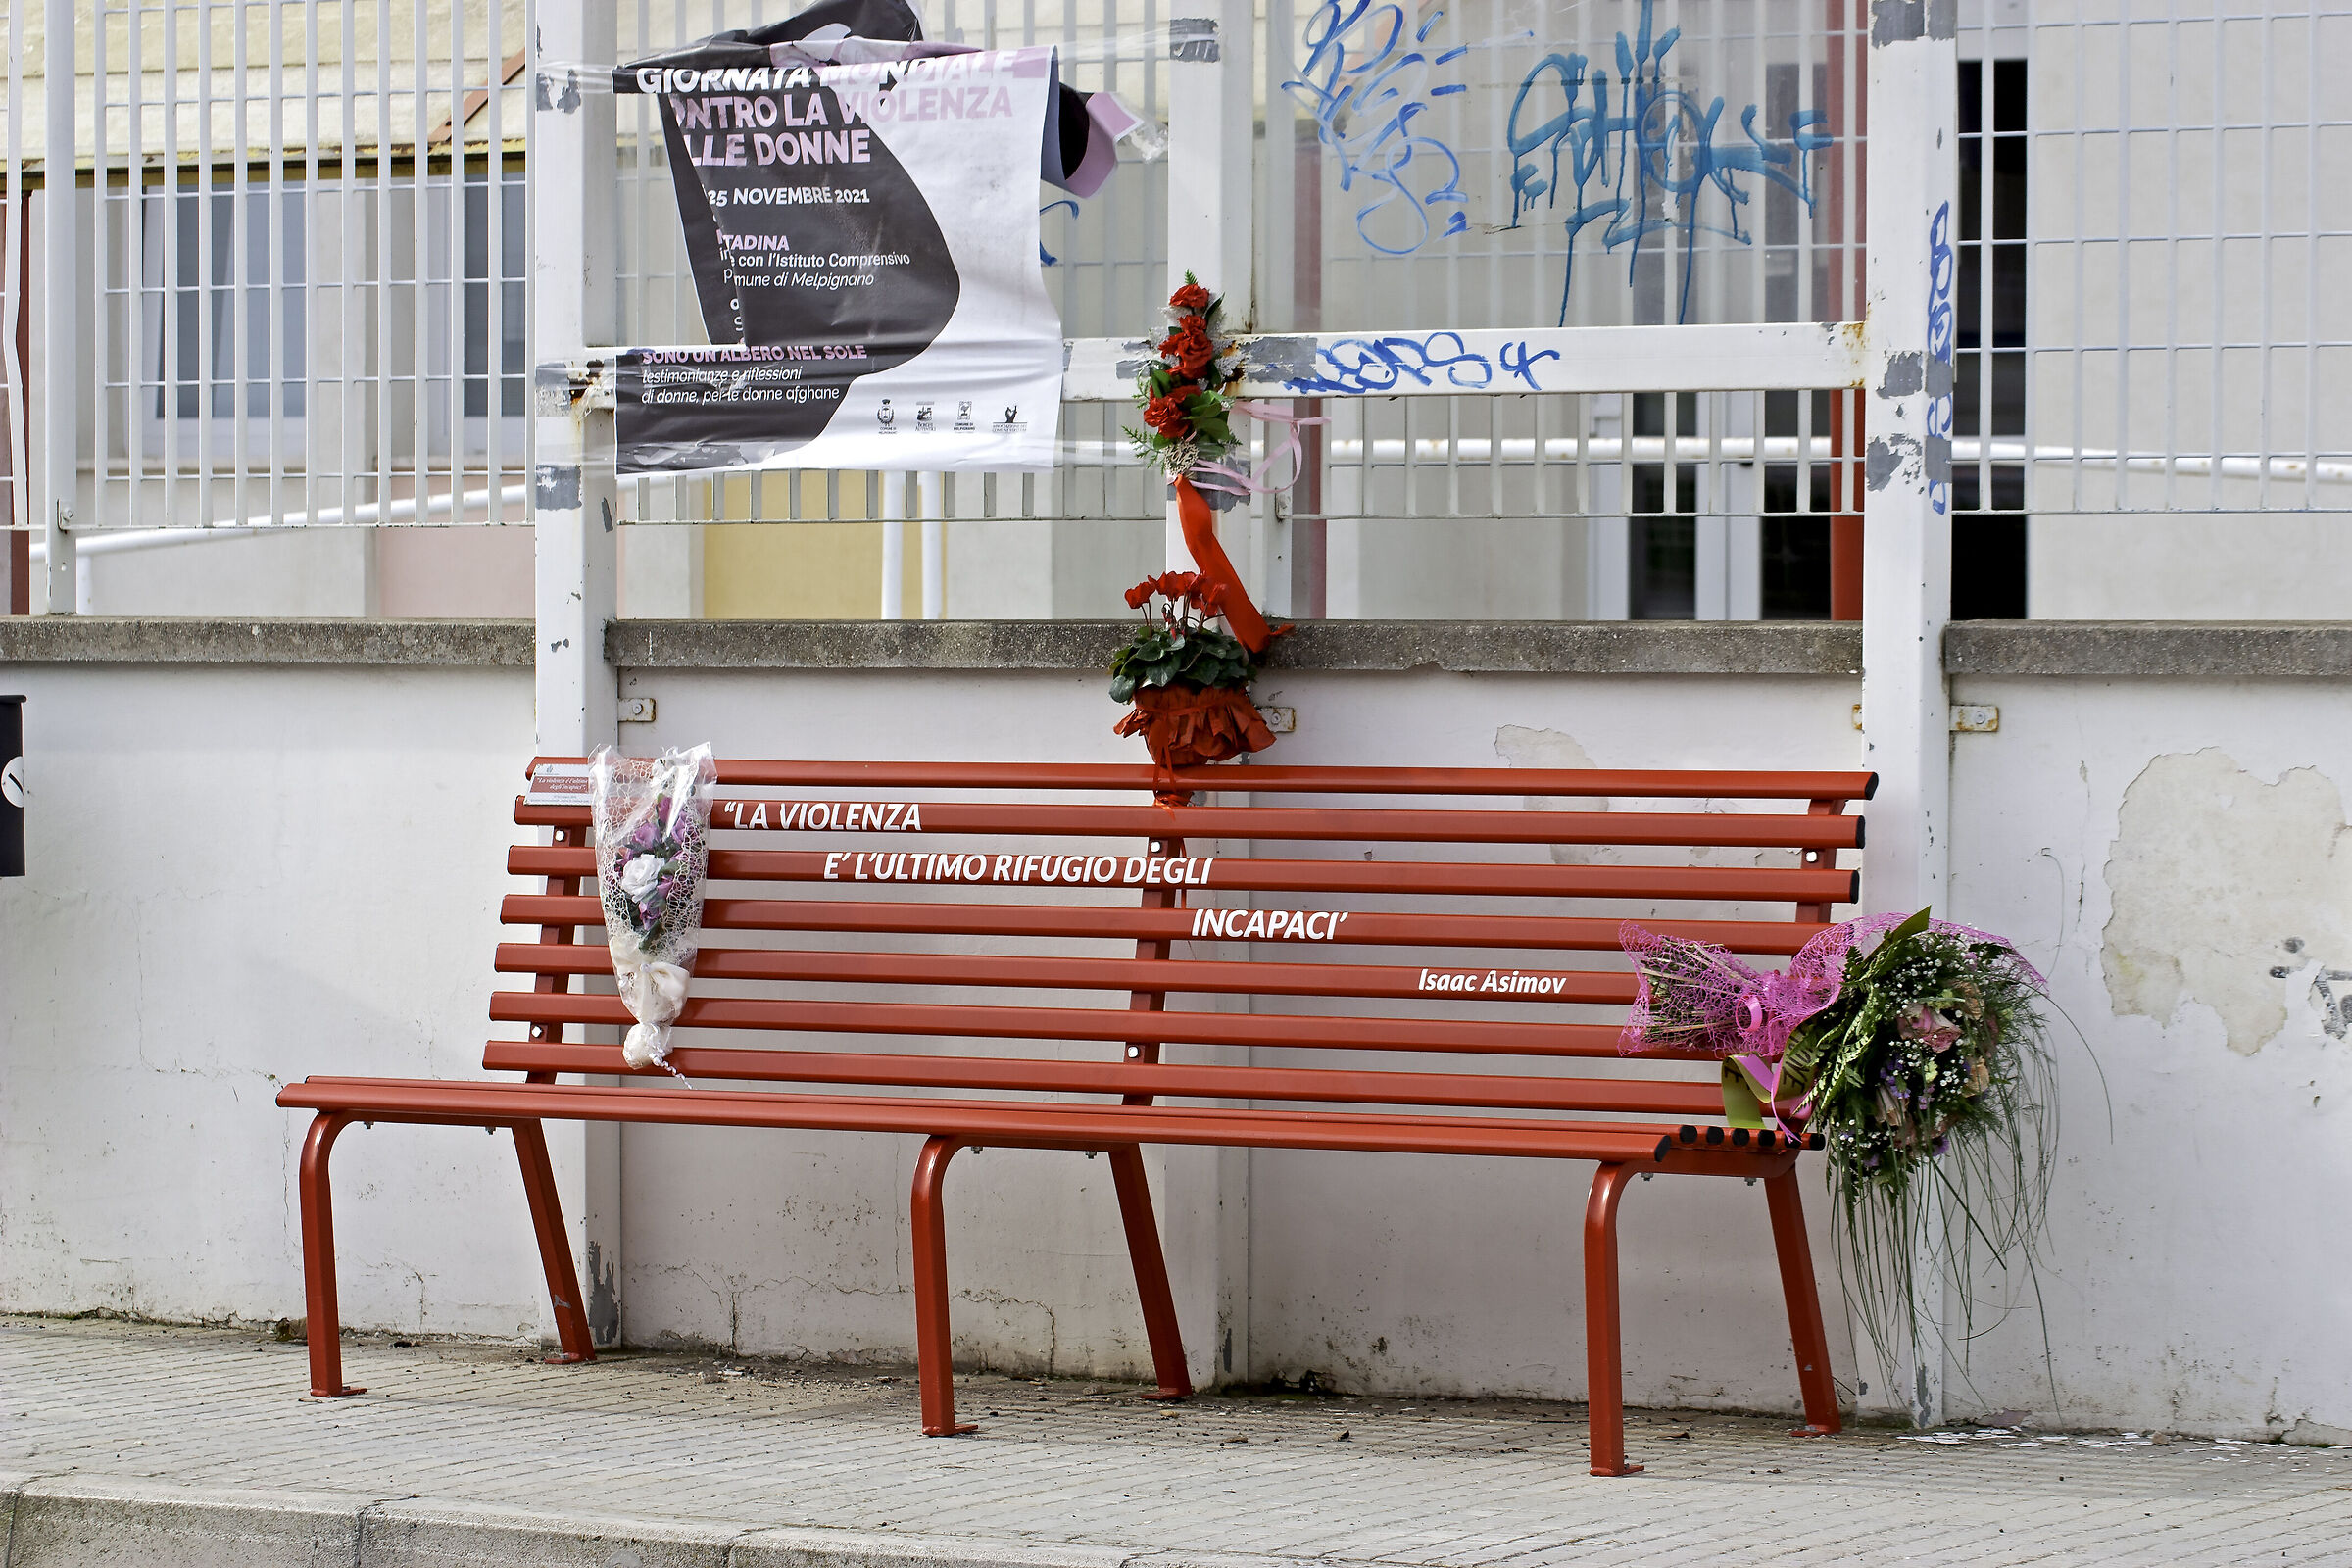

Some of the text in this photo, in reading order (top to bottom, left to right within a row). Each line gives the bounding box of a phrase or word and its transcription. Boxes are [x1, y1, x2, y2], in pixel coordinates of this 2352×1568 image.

[636, 65, 812, 94] GIORNATA
[784, 93, 829, 126] LA
[836, 85, 1013, 124] VIOLENZA
[754, 128, 871, 166] DONNE
[708, 187, 870, 207] 25 NOVEMBRE 2021
[738, 255, 764, 268] con
[767, 253, 825, 268] l'Istituto
[828, 251, 910, 270] Comprensivo
[773, 272, 788, 286] di
[791, 272, 874, 290] Melpignano
[720, 345, 784, 362] ALBERO
[786, 345, 821, 360] NEL
[824, 345, 868, 360] SOLE
[642, 389, 655, 404] di
[657, 389, 700, 404] donne,
[743, 386, 783, 401] donne
[785, 385, 840, 403] afghane
[779, 803, 922, 831] VIOLENZA
[854, 852, 987, 880] L'ULTIMO
[992, 856, 1119, 882] RIFUGIO
[1122, 857, 1215, 885] DEGLI
[1191, 908, 1349, 940] INCAPACI'
[1418, 968, 1567, 995] Isaac Asimov
